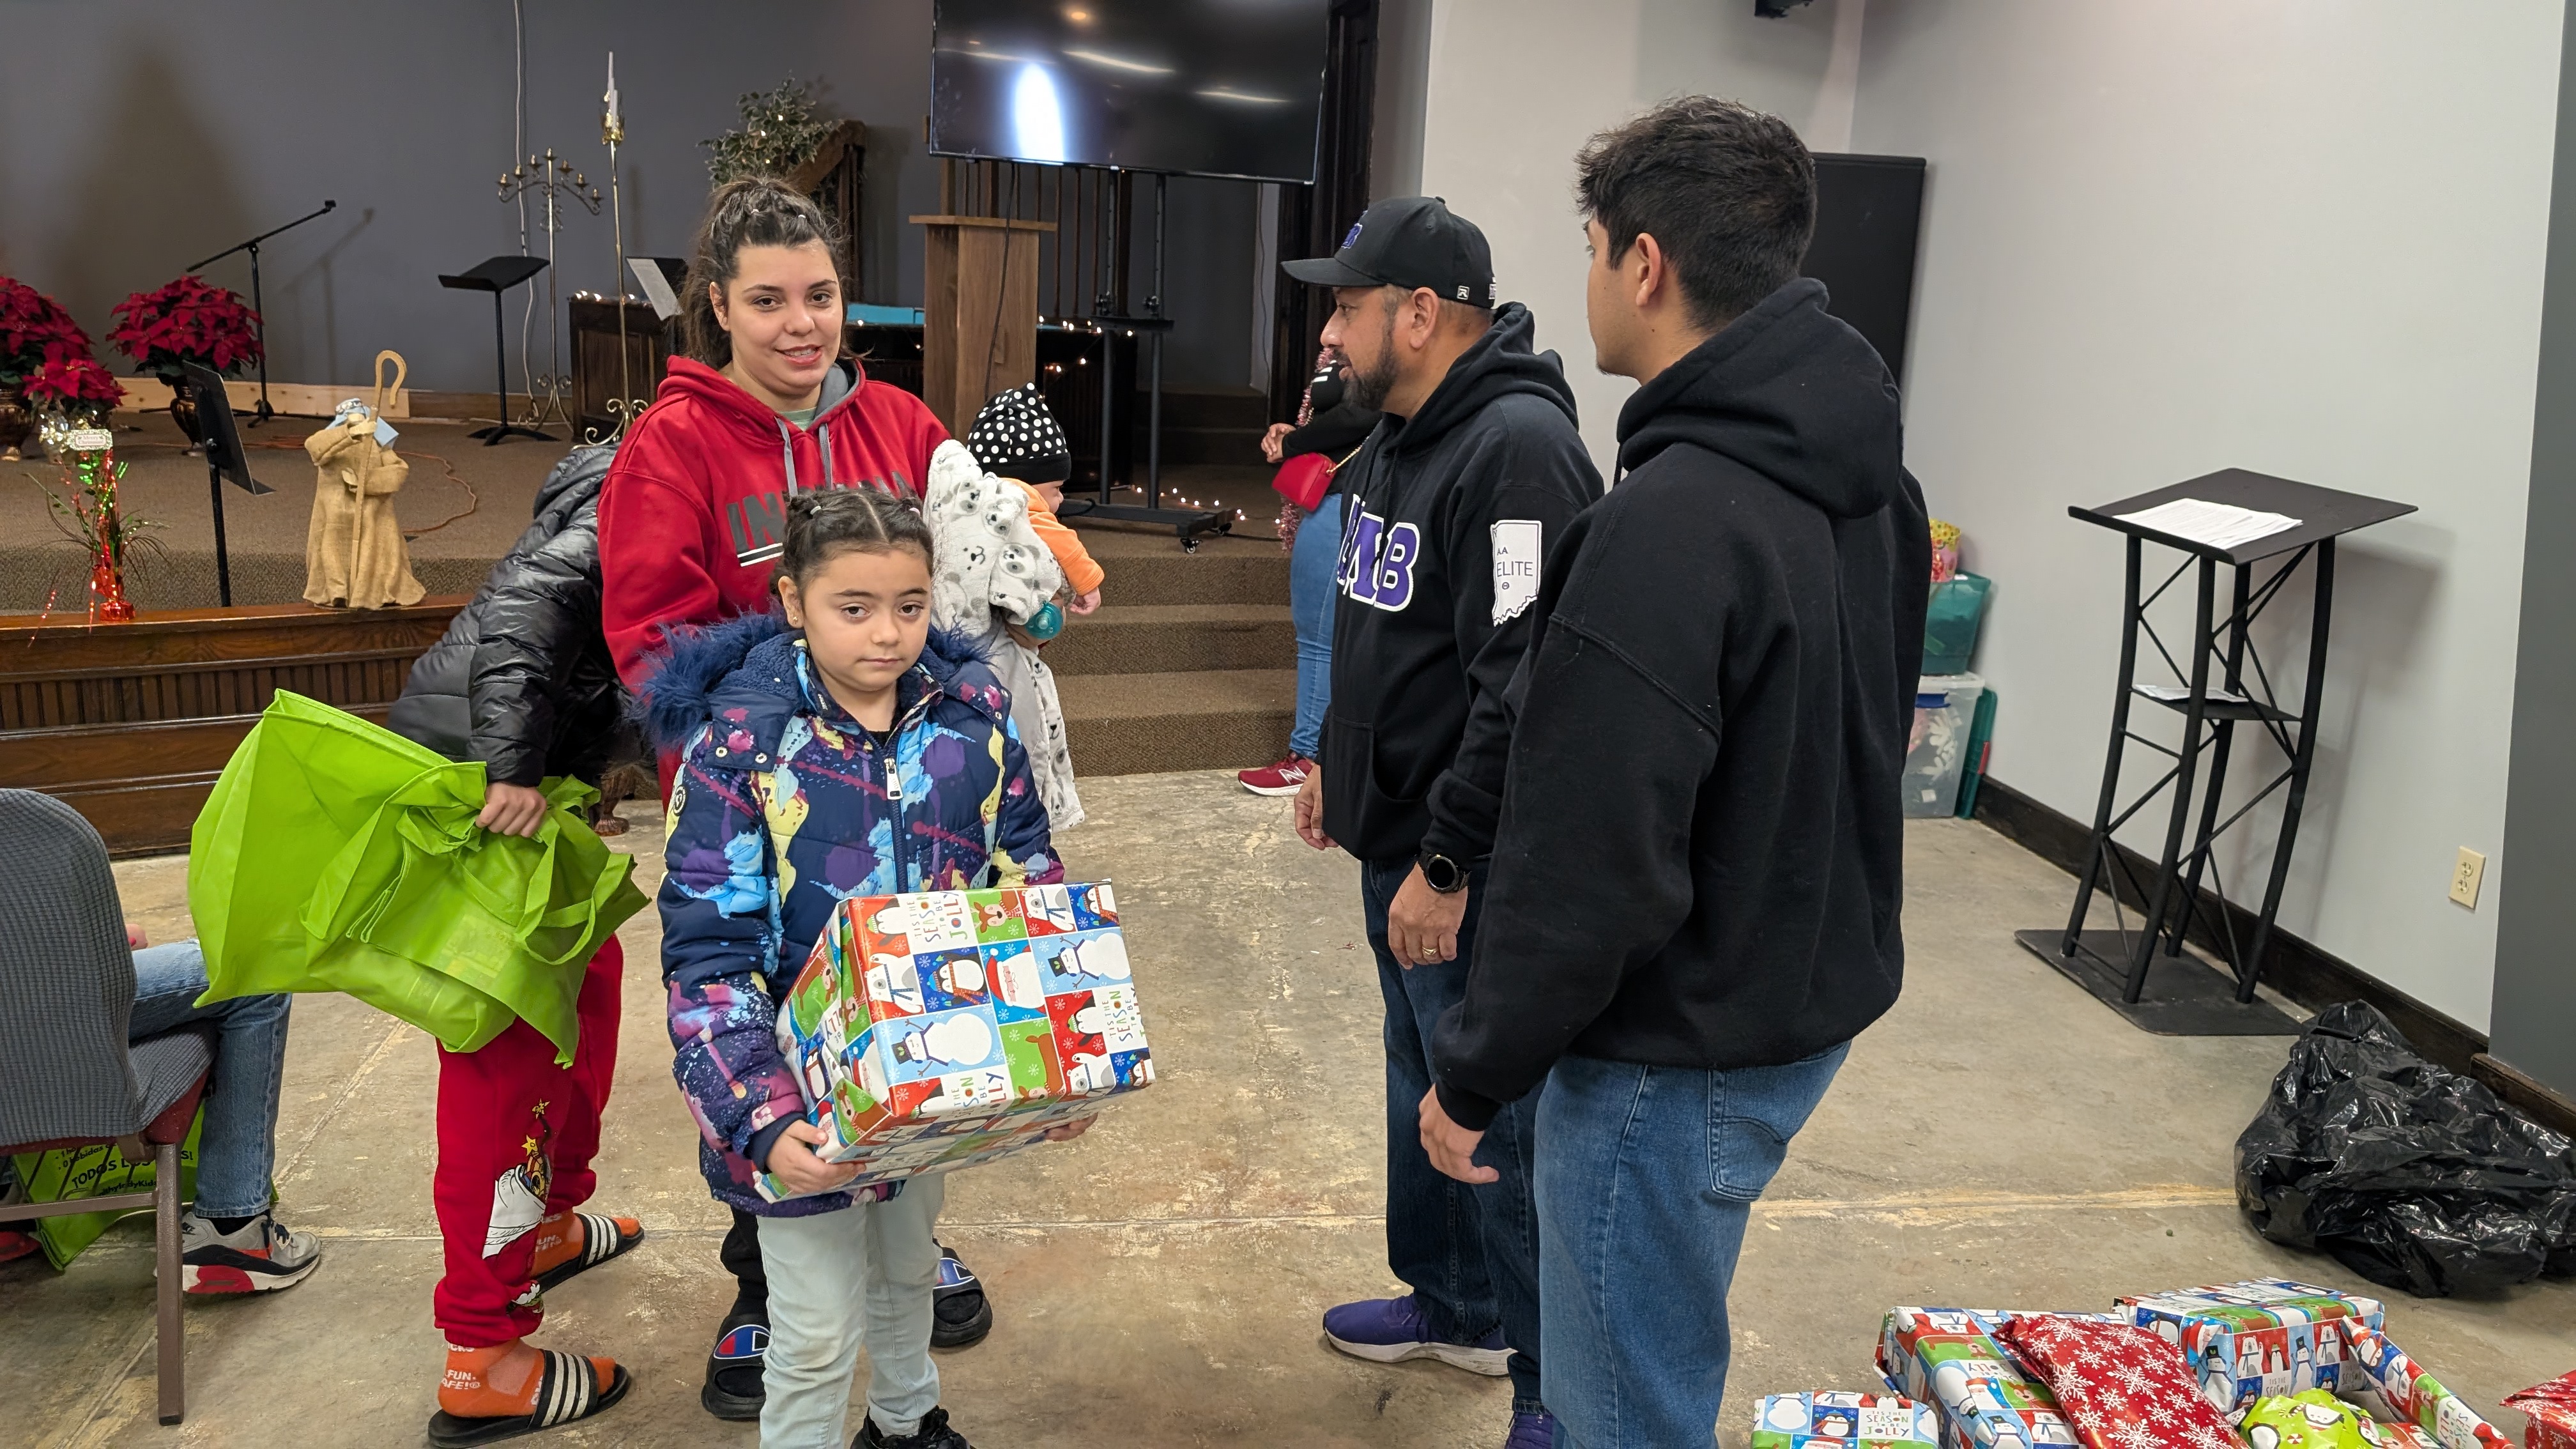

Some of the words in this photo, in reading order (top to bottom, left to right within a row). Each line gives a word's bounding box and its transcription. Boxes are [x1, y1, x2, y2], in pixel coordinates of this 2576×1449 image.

[1496, 561, 1533, 578] ELITE
[907, 901, 917, 917] THE
[933, 900, 943, 912] BE
[914, 893, 942, 943] SEASON
[939, 891, 968, 940] JOLLY
[1101, 1000, 1112, 1017] THE
[1124, 999, 1133, 1011] BE
[1108, 990, 1133, 1042] SEASON
[978, 1085, 988, 1099] BE
[71, 1160, 118, 1189] TODOS
[1866, 1414, 1909, 1423] SEASON
[1864, 1426, 1910, 1437] JOLLY
